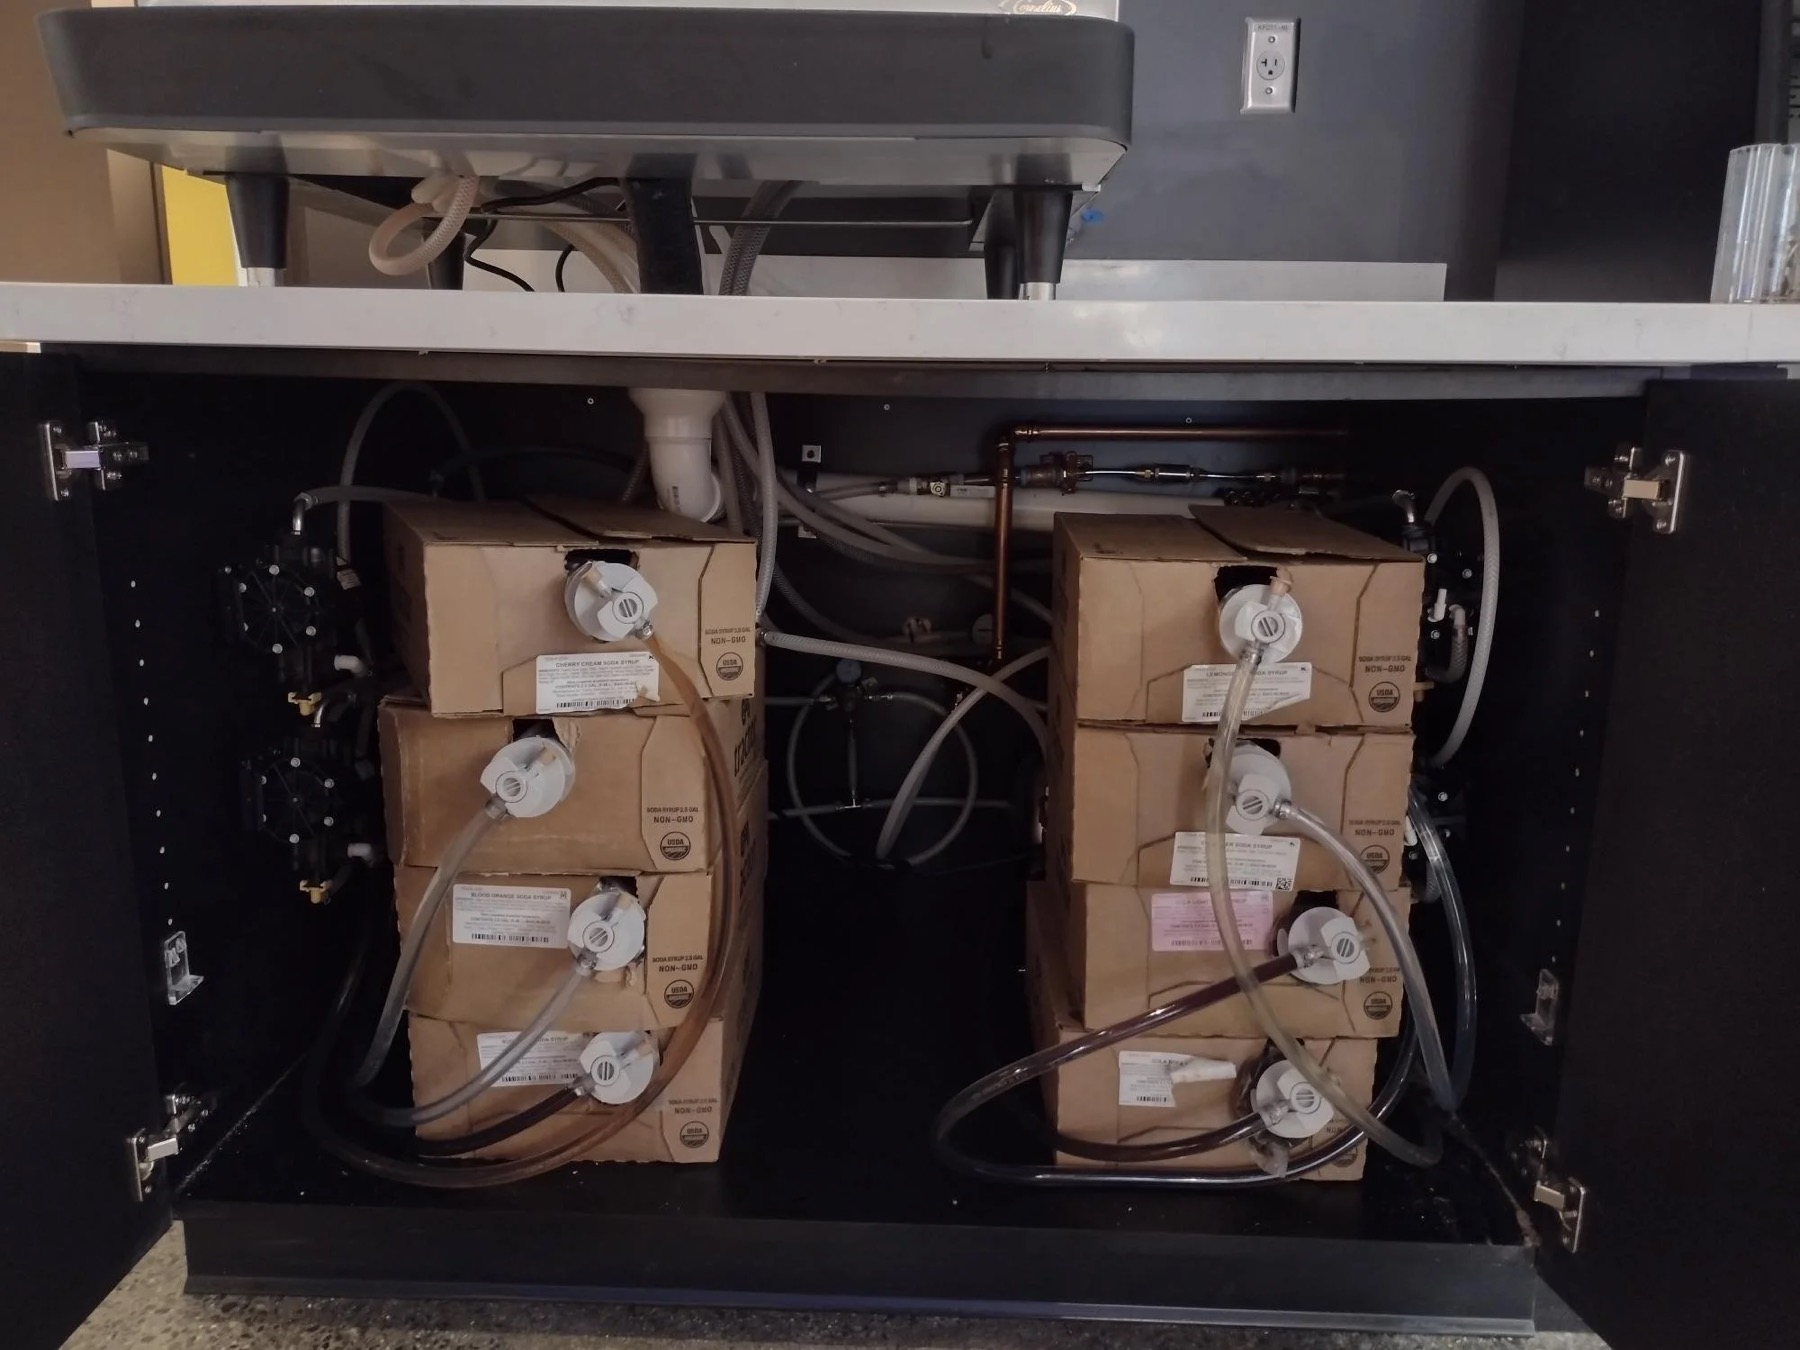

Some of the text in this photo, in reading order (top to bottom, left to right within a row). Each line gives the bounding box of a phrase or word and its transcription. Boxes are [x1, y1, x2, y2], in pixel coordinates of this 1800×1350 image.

[711, 636, 746, 644] NON-GMO
[1365, 665, 1405, 673] NON-GMO
[653, 815, 694, 823] NON-GMO
[1354, 828, 1395, 836] NON-GMO
[658, 963, 698, 972] NON-GMO
[674, 1106, 713, 1114] NON-GMO
